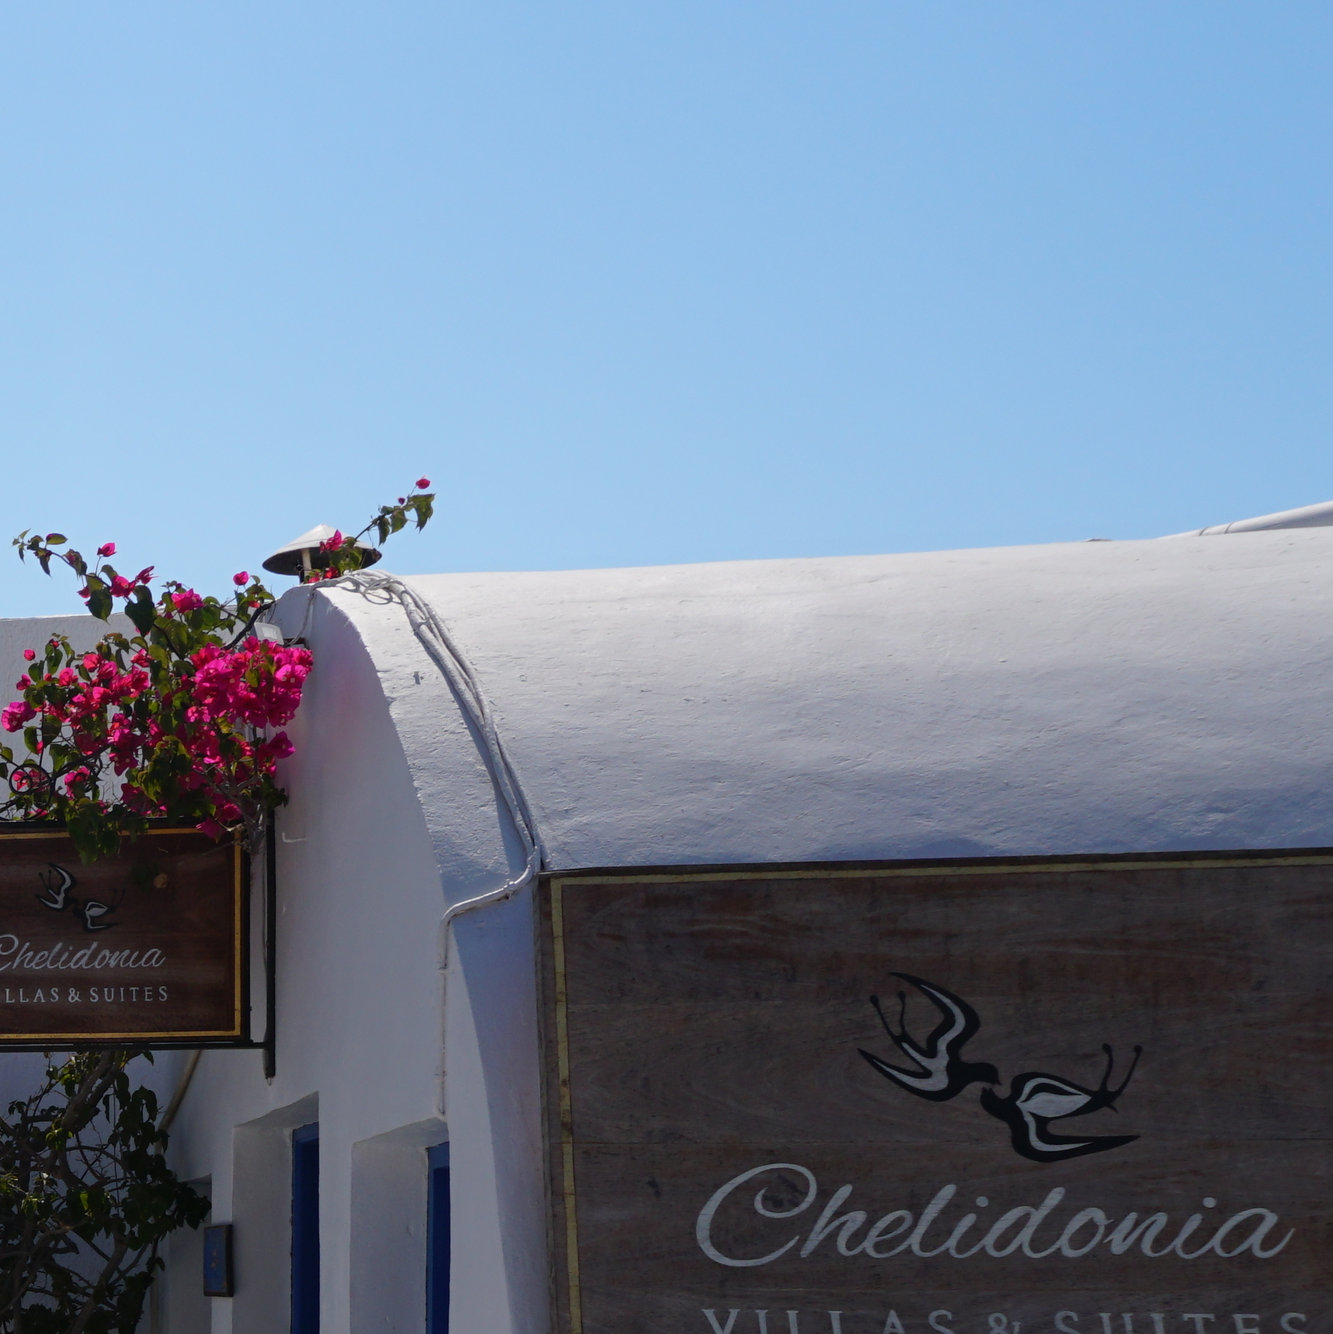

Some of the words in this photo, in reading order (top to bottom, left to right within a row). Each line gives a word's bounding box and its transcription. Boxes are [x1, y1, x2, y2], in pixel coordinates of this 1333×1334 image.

[68, 987, 82, 1003] &
[90, 985, 168, 1002] SUITES
[695, 1162, 1297, 1267] Chelidonia
